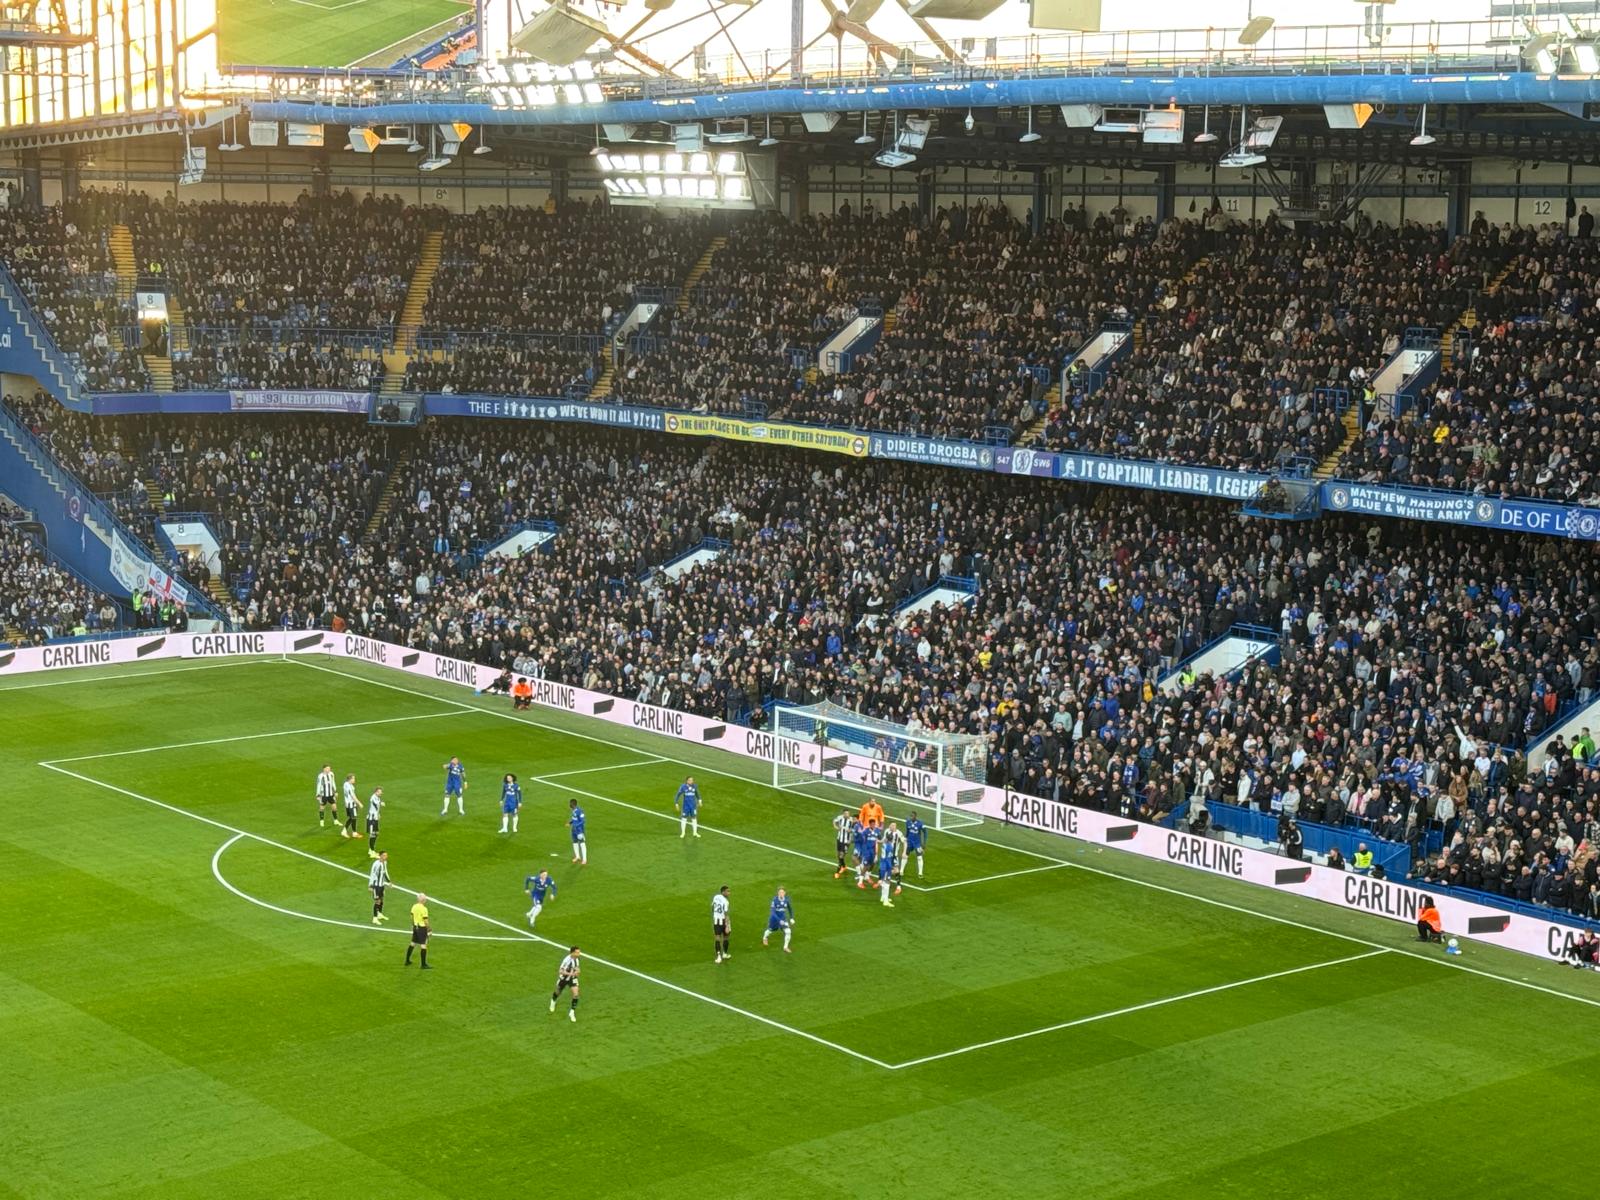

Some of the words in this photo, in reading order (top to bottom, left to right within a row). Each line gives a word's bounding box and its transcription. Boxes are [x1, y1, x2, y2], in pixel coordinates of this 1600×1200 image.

[1227, 200, 1239, 212] 11
[1534, 201, 1551, 215] 12
[147, 294, 154, 304] 8
[1414, 353, 1427, 364] 12
[246, 394, 265, 404] ONE
[282, 393, 313, 405] KERRY
[315, 394, 343, 406] DIXON
[469, 401, 487, 414] THE
[560, 405, 588, 420] WE'VE
[590, 407, 608, 421] WON
[619, 411, 632, 424] ALL
[681, 419, 692, 430] THE
[711, 420, 730, 434] PLACE
[770, 428, 790, 440] EVERY
[792, 430, 814, 443] OTHER
[815, 432, 850, 448] SATURDAY
[887, 439, 925, 454] DIDIER
[929, 443, 978, 460] DROGBA
[1080, 459, 1094, 478] JT
[1098, 463, 1157, 488] CAPTAIN,
[1160, 468, 1213, 494] LEADER,
[1215, 475, 1267, 497] LEGEN
[1350, 488, 1406, 504] MATTHEW
[1410, 499, 1475, 510] HARDING'S
[1352, 498, 1381, 511] BLUE
[1385, 501, 1393, 513] &
[1396, 506, 1434, 519] WHITE
[1437, 509, 1471, 520] ARMY
[177, 524, 185, 534] 8
[1526, 511, 1551, 528] OF
[192, 635, 264, 655] CARLING
[345, 636, 387, 663] CARLING
[1245, 643, 1258, 654] 12
[43, 643, 110, 668] CARLING
[435, 658, 477, 686] CARLING
[530, 679, 575, 709] CARLING
[633, 704, 682, 735] CARLING
[746, 731, 800, 765] CARLING
[1010, 795, 1078, 834] CARLING
[1167, 833, 1243, 876] CARLING
